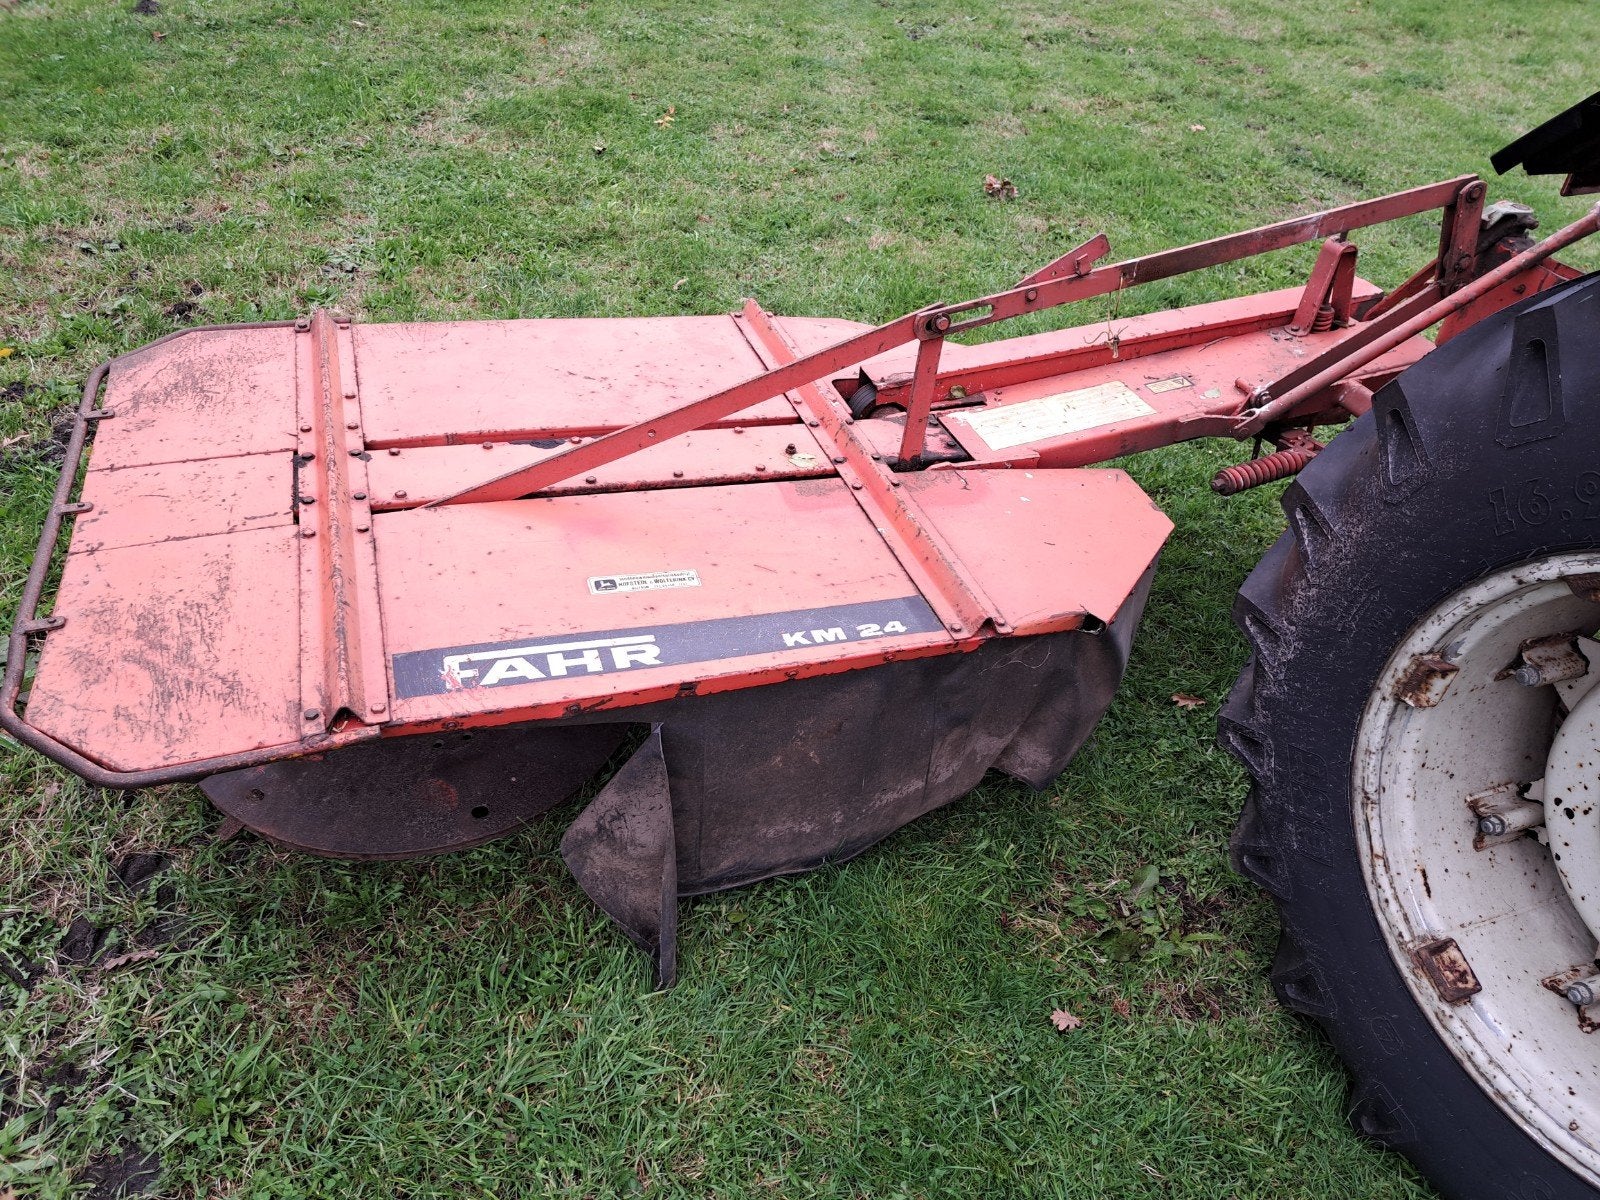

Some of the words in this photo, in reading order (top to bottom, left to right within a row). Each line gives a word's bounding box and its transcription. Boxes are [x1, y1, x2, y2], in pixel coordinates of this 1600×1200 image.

[441, 634, 664, 690] FAHR
[781, 626, 848, 647] KM
[855, 620, 908, 638] 24
